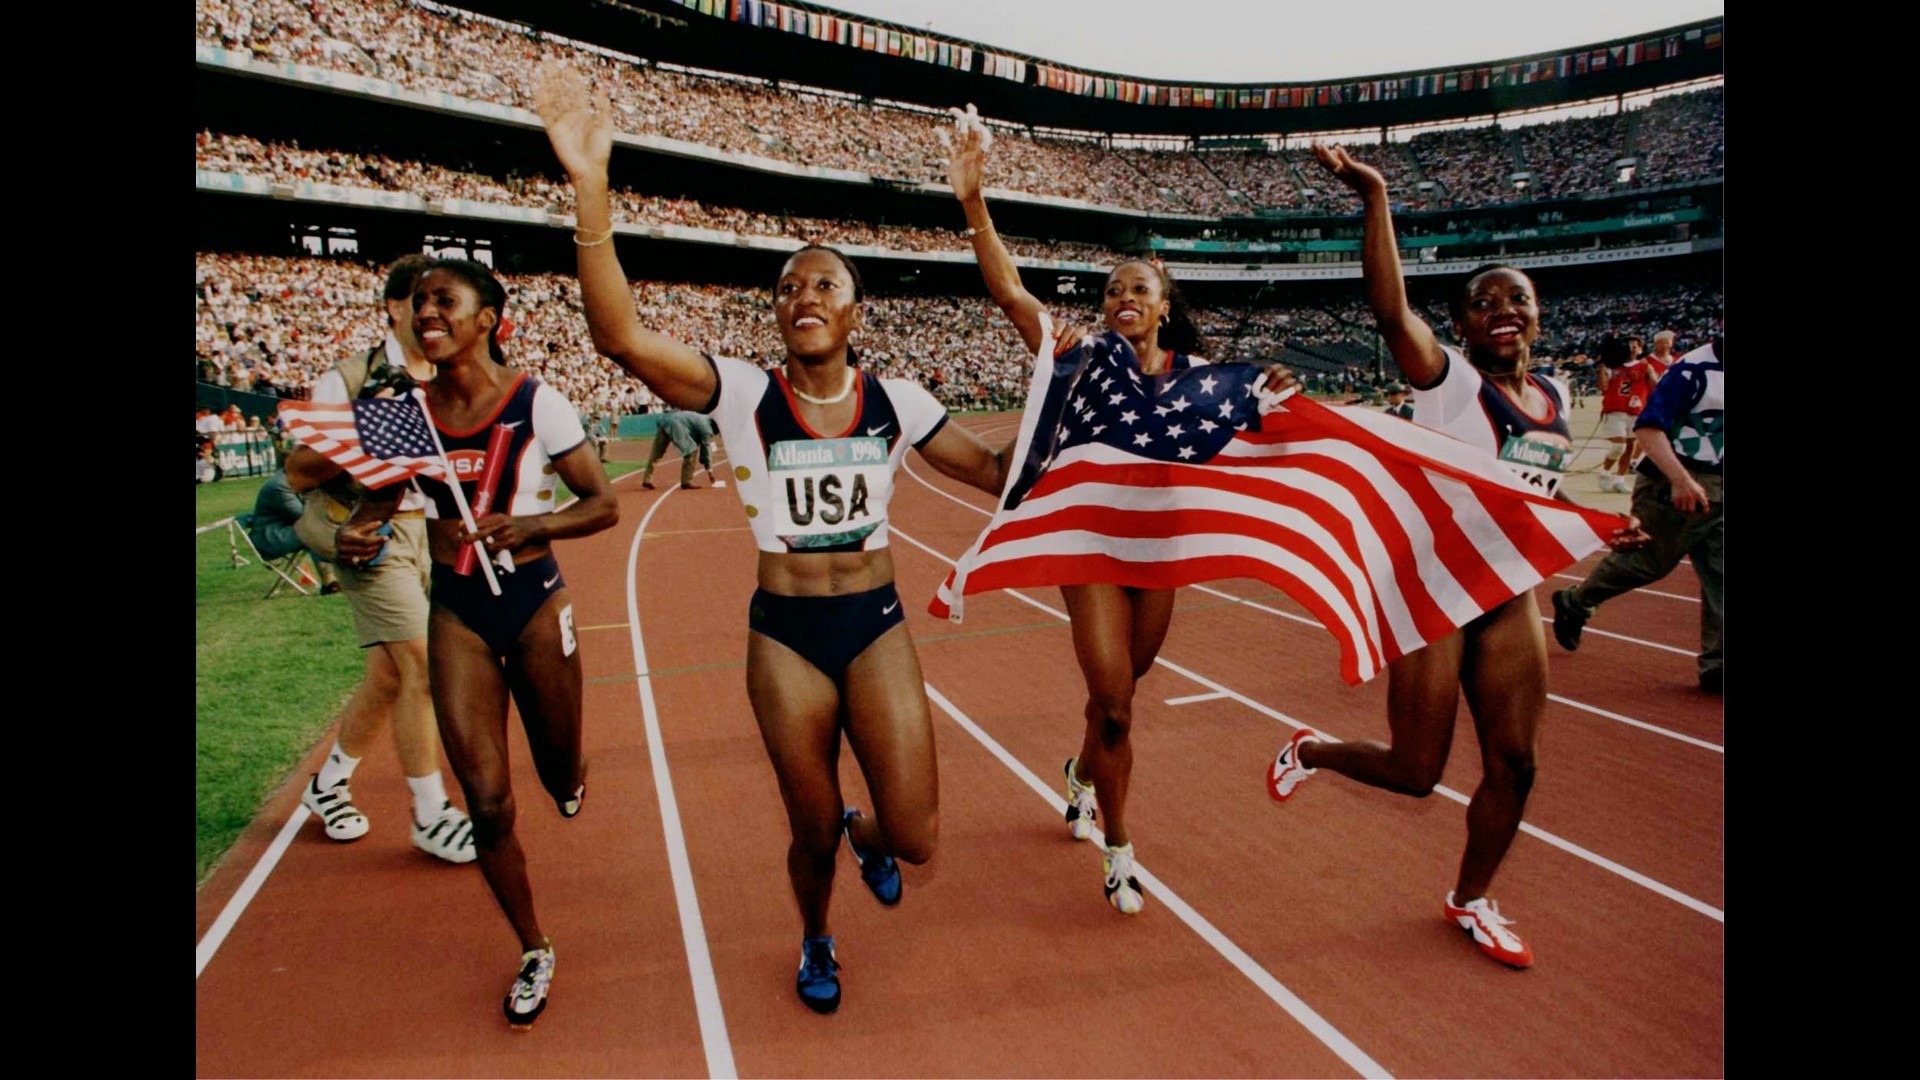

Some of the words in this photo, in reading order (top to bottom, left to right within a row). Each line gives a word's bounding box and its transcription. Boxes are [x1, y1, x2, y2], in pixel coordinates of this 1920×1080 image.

[1619, 380, 1632, 396] 2
[775, 444, 833, 467] Atlanta
[851, 440, 882, 461] 1996
[1507, 441, 1550, 466] Atlanta
[785, 474, 870, 526] USA
